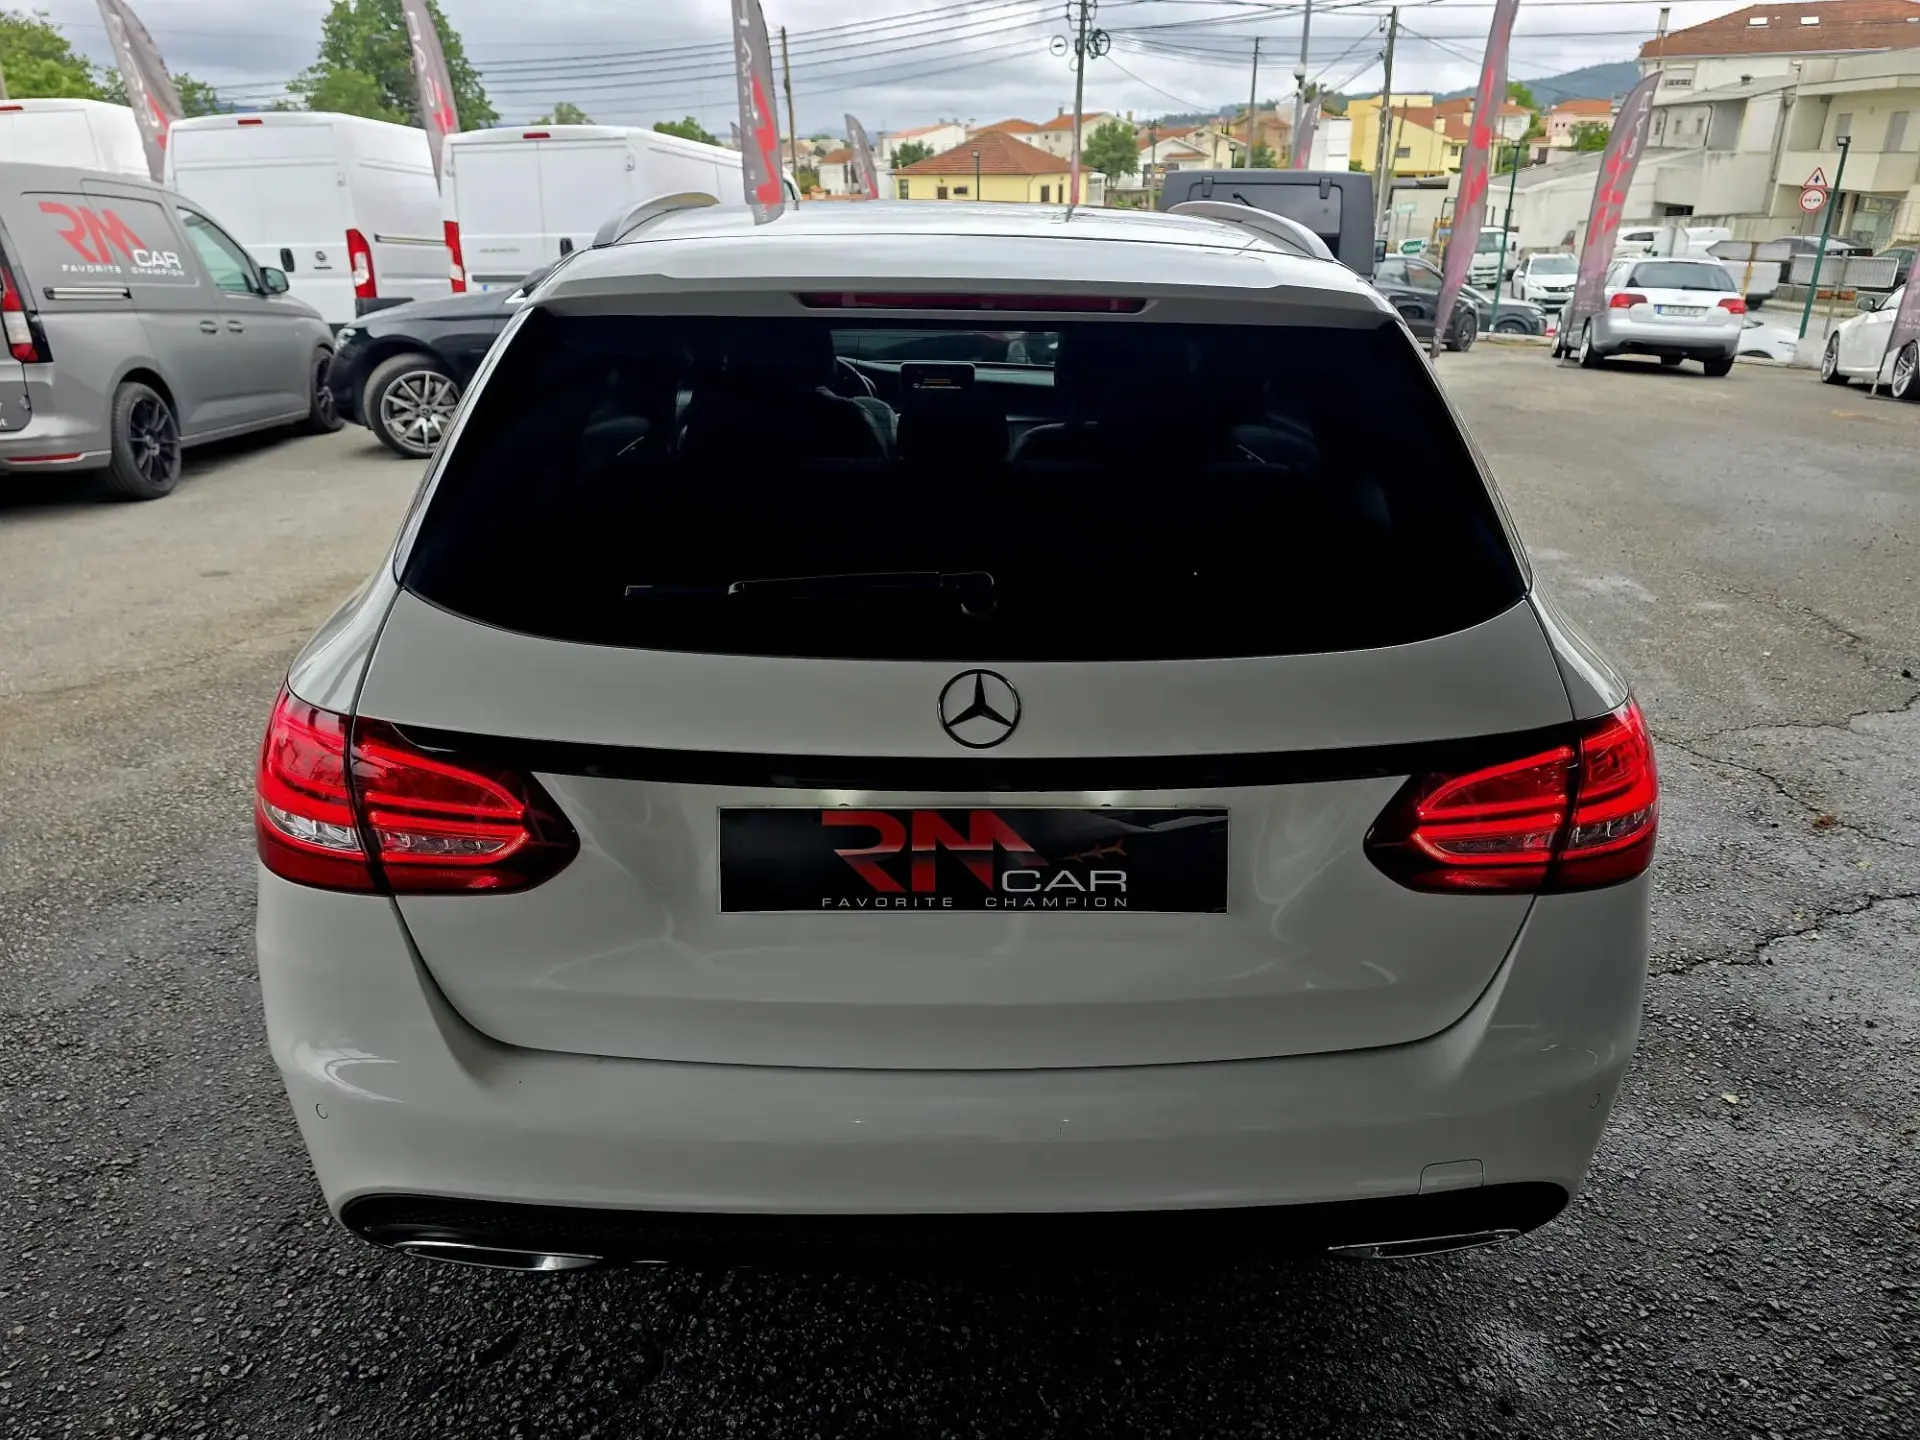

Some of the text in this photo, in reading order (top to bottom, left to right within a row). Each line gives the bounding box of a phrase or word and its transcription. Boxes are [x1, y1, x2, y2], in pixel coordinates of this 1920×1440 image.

[38, 200, 183, 269] RM CAR
[61, 264, 122, 274] FAVORITE
[821, 810, 1127, 893] RM CAR
[821, 896, 1128, 908] FAVORITE CHAMPION
